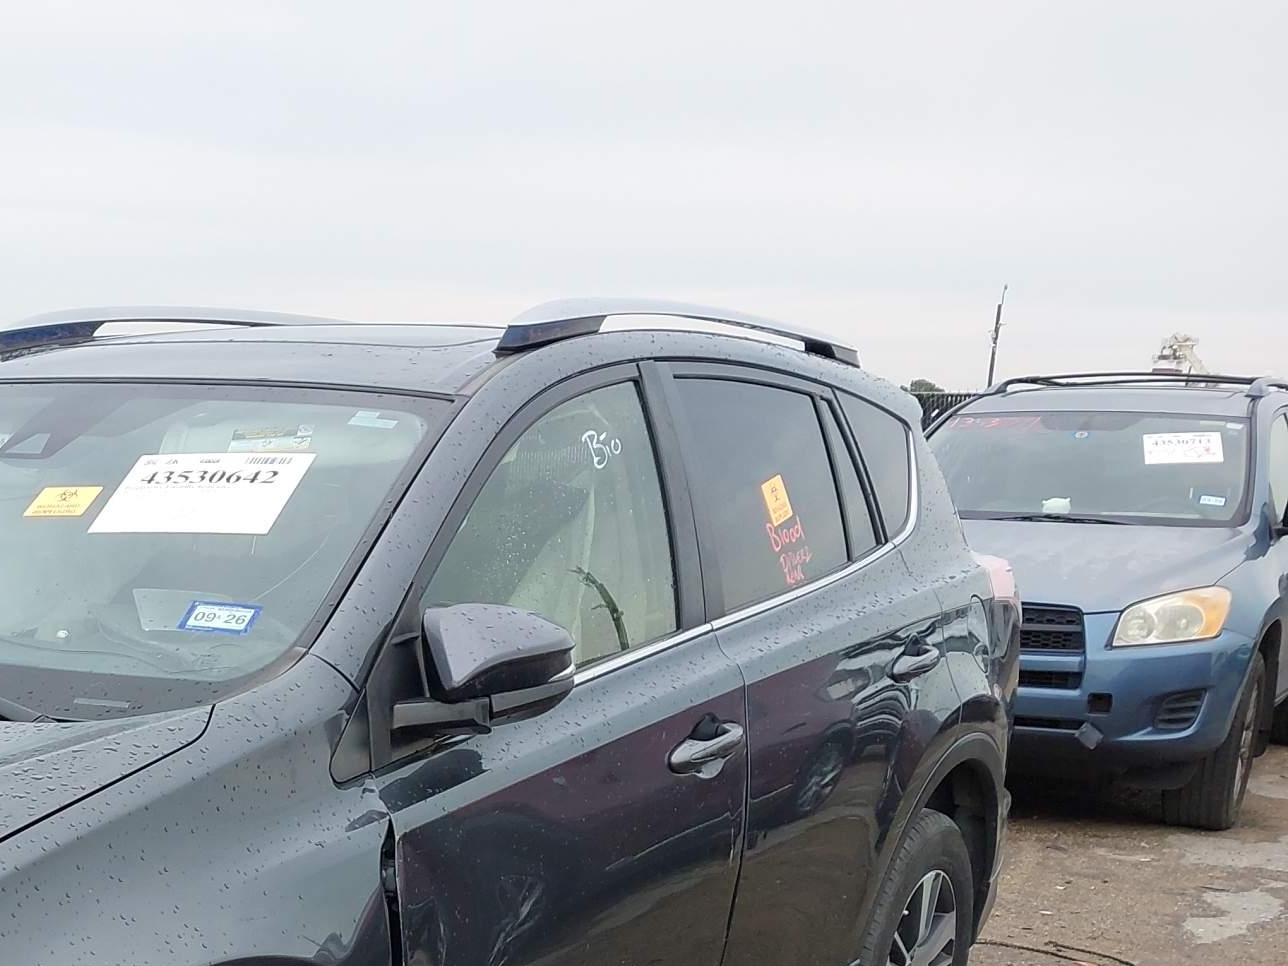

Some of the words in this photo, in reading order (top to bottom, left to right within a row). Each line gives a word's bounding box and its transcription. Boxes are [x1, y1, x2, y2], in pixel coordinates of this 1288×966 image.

[141, 470, 279, 485] 43530642
[766, 515, 805, 552] Blood
[194, 612, 216, 622] 09
[224, 614, 247, 625] 26
